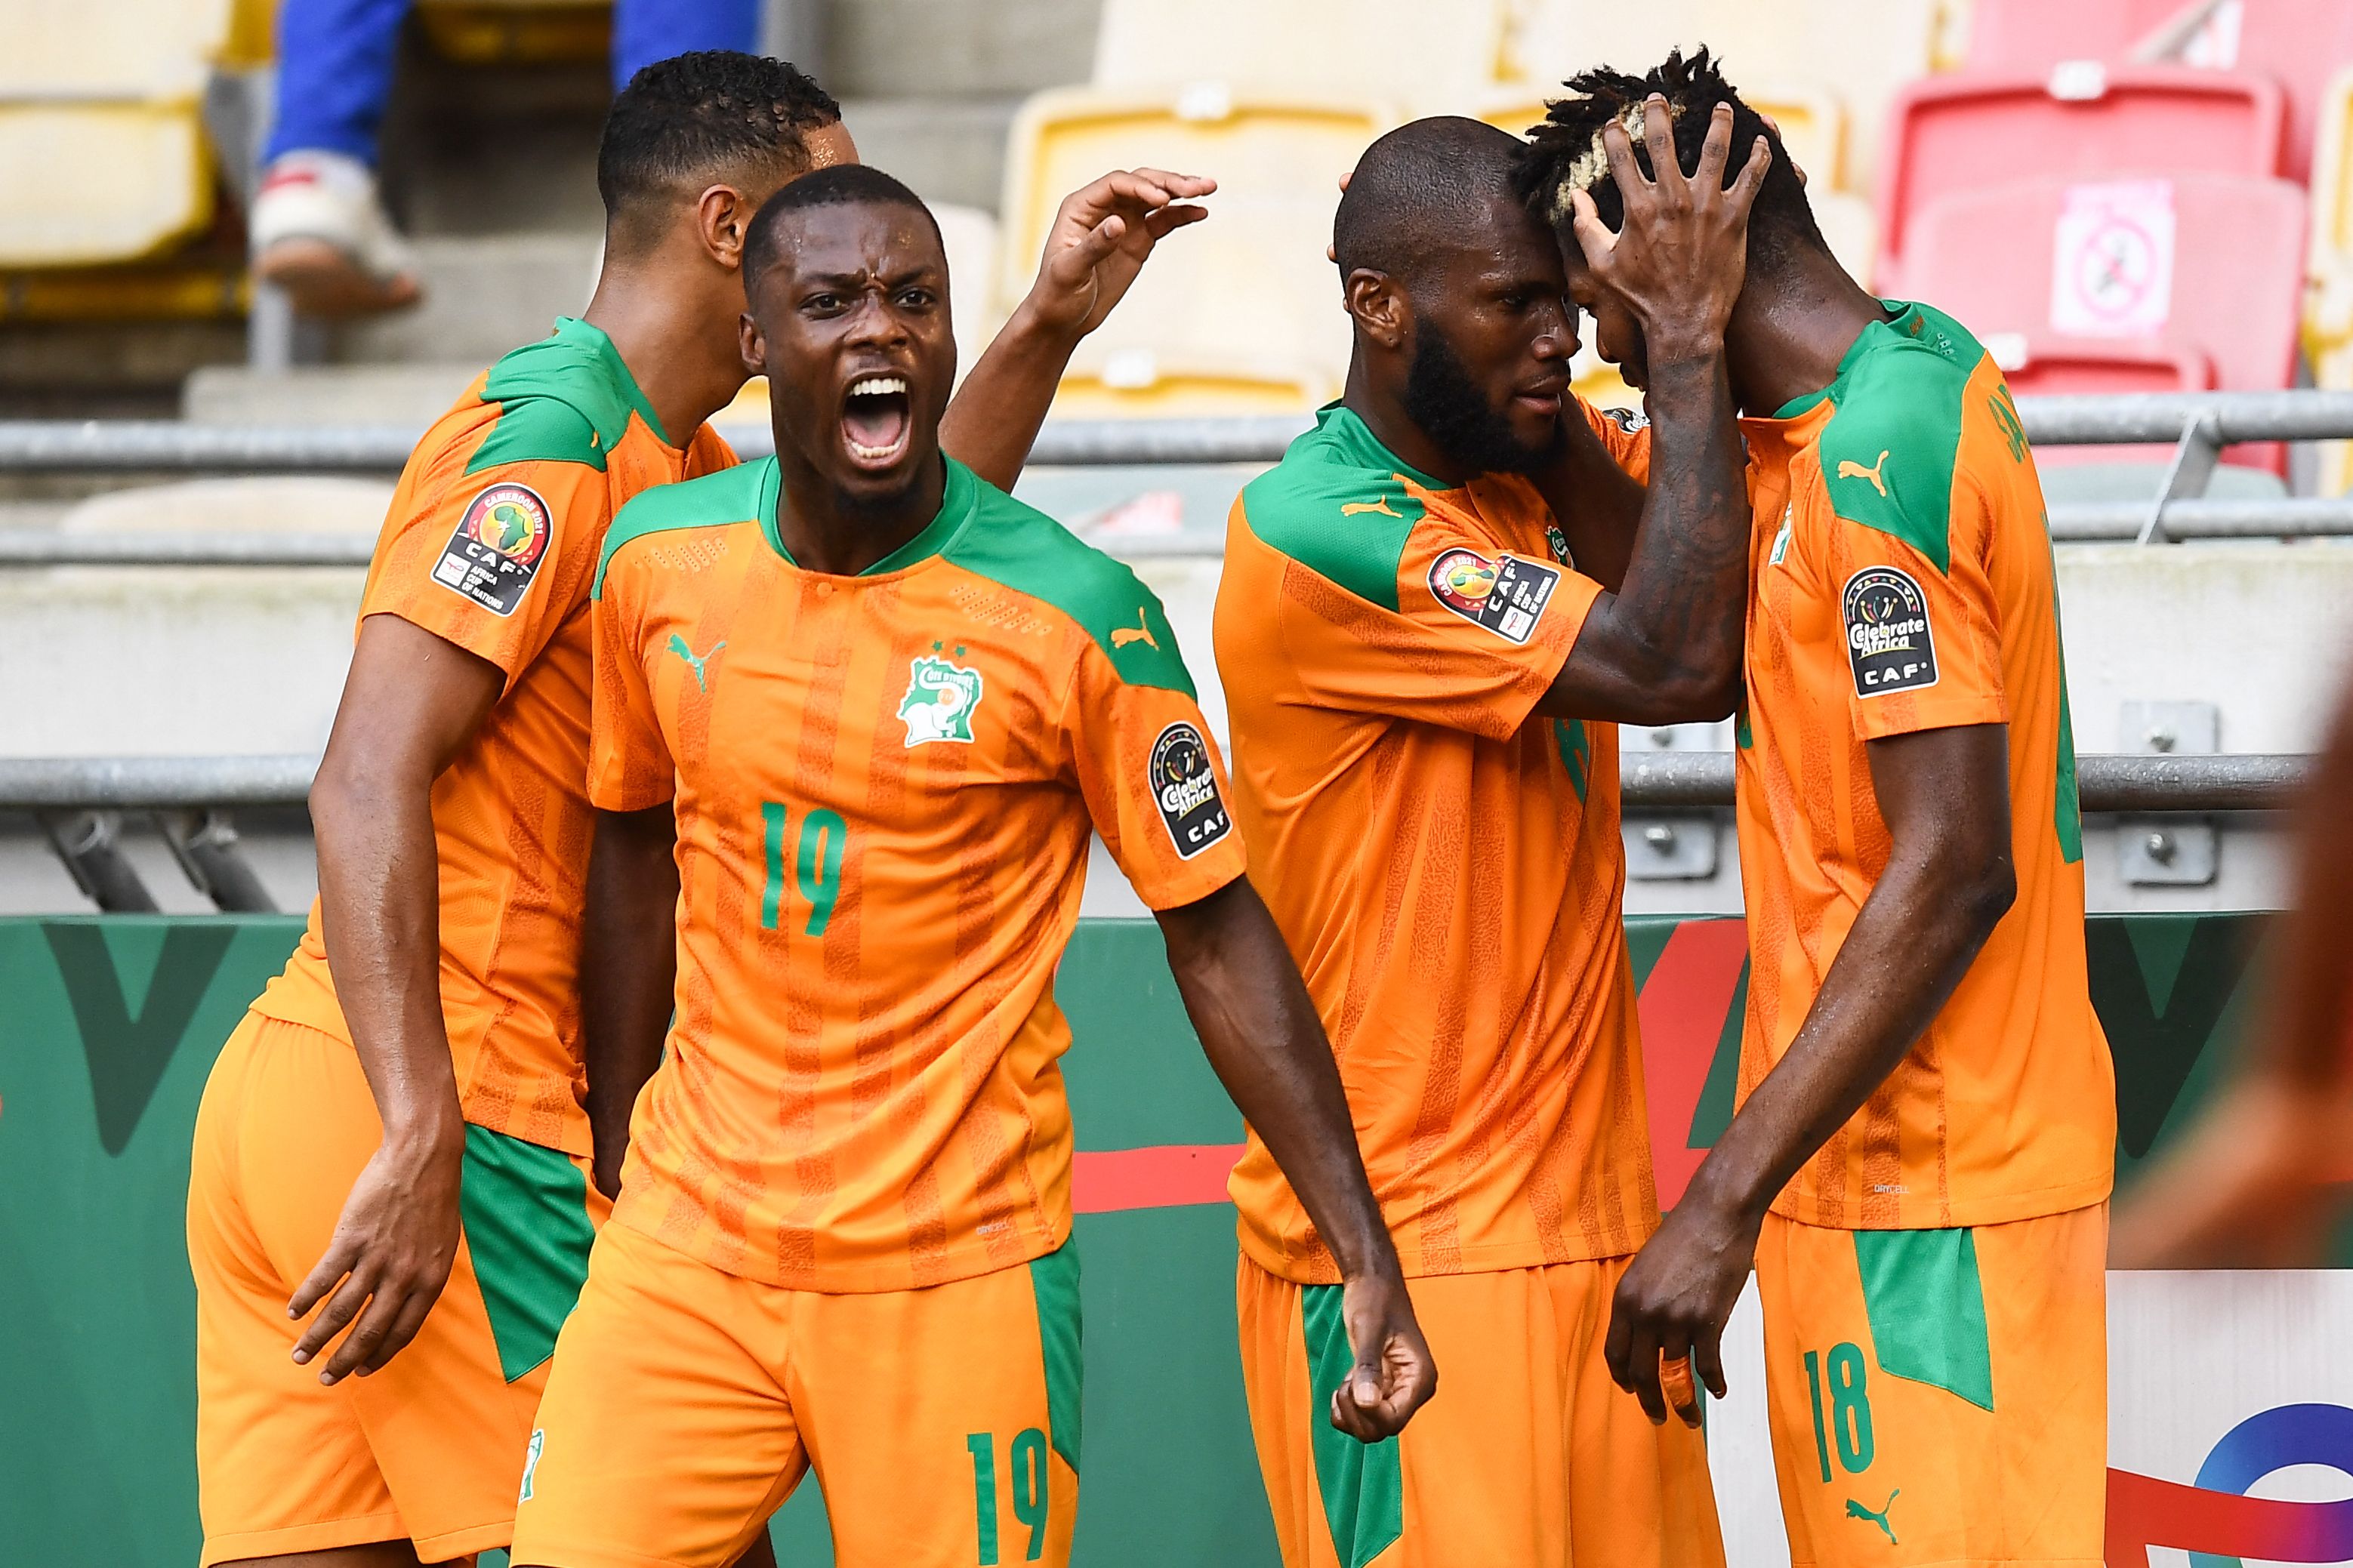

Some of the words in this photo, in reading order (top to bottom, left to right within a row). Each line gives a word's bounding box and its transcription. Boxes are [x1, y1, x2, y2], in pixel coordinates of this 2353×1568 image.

[484, 492, 536, 512] CAMEROON
[531, 510, 543, 534] 2021
[465, 542, 517, 575] CAF
[466, 574, 483, 586] CUP
[470, 565, 498, 585] AFRICA
[1488, 563, 1516, 612] CAF
[461, 581, 474, 592] OF
[472, 588, 504, 610] NATIONS
[1850, 618, 1925, 649] Celebrate
[1861, 635, 1910, 656] Africa
[1864, 663, 1919, 685] CAF
[1179, 784, 1214, 818] Africa
[761, 801, 847, 937] 19
[1874, 1184, 1910, 1194] DRYCELL
[1803, 1342, 1874, 1483] 18
[967, 1428, 1048, 1566] 19
